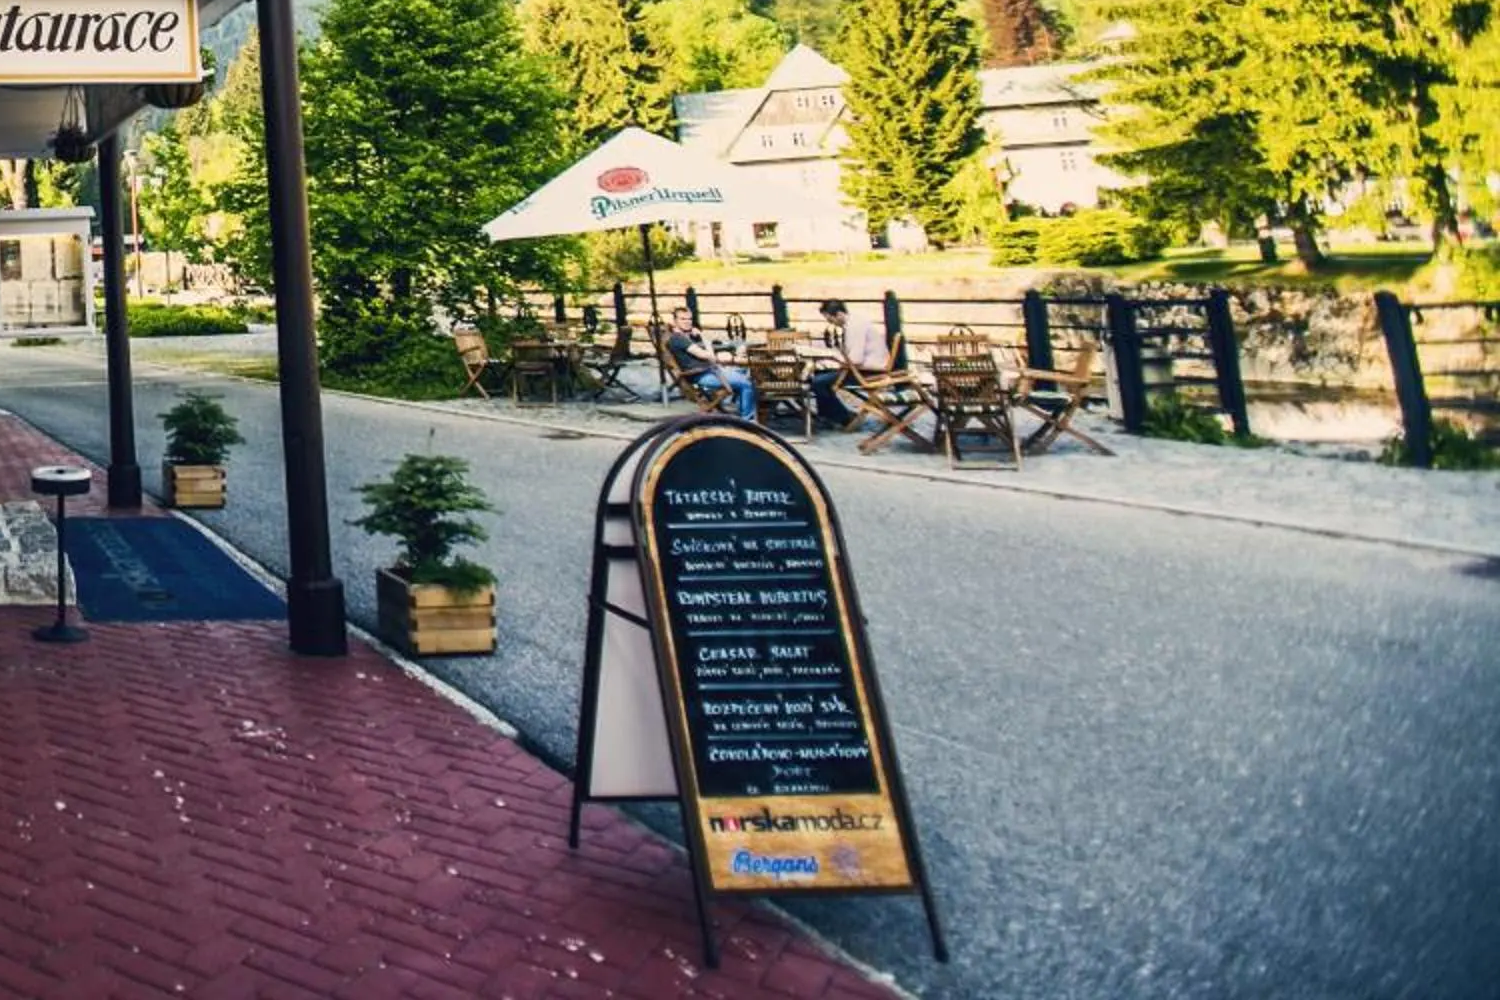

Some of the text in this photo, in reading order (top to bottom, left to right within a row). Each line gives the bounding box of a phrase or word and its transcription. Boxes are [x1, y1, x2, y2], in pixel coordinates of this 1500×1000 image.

[590, 186, 723, 219] Pilsner Urquell
[733, 849, 819, 878] Bergans
